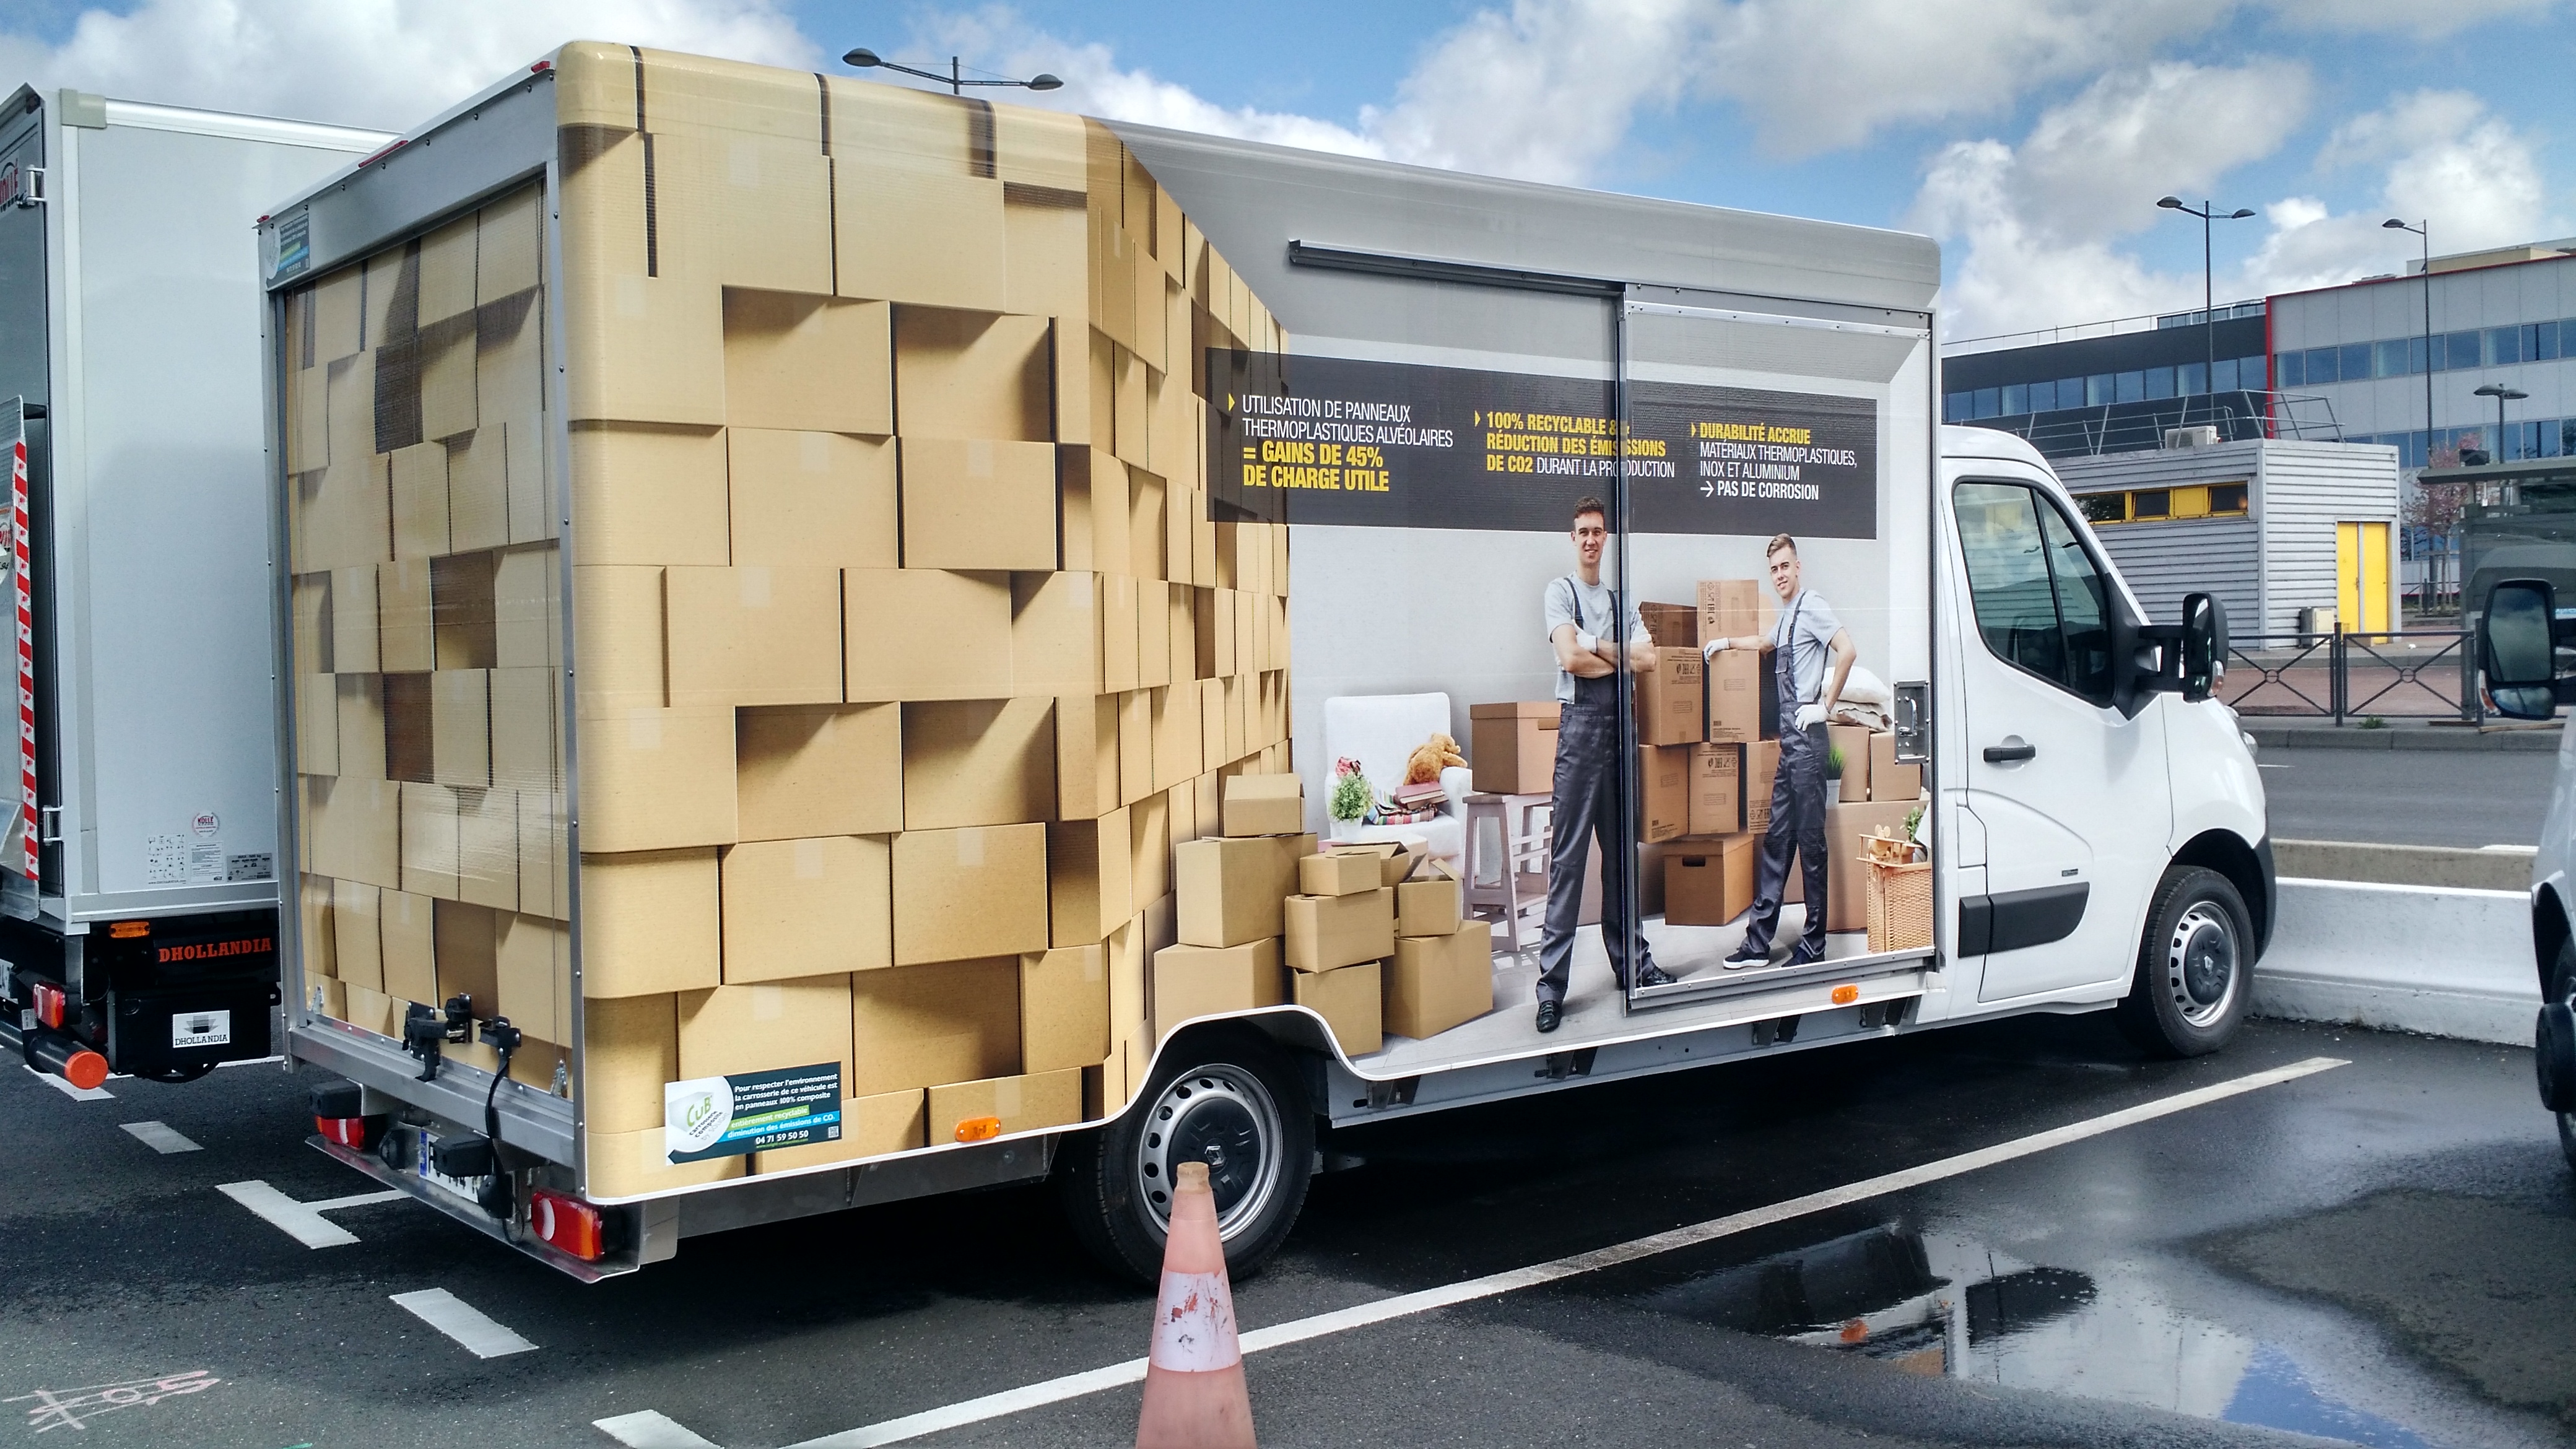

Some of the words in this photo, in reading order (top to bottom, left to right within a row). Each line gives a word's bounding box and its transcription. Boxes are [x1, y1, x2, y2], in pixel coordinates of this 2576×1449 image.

[1243, 394, 1320, 417] UTILISATION
[1325, 400, 1342, 419] DE
[1346, 401, 1411, 422] PANNEAUX
[1242, 418, 1373, 443] THERMOPLASTIQUES
[1376, 423, 1453, 447] ALVÉOLAIRES
[1487, 411, 1523, 430] 100%
[1528, 414, 1606, 435] RECYCLABLE
[1700, 422, 1765, 442] DURABILITÉ
[1767, 427, 1811, 445] ACCRUE
[1487, 429, 1558, 453] RÉDUCTION
[1562, 437, 1586, 455] DES
[1700, 439, 1757, 460] MATÉRIAUX
[1757, 445, 1857, 468] THERMOPLASTIQUES,
[1262, 440, 1315, 464] GAINS
[1320, 443, 1342, 466] DE
[1346, 445, 1383, 468] 45%
[1487, 454, 1504, 471] DE
[1507, 455, 1533, 473] CO2
[1537, 457, 1582, 475] DURANT
[1583, 459, 1597, 476] LA
[1243, 464, 1266, 486] DE
[1271, 466, 1340, 490] CHARGE
[1344, 469, 1389, 492] UTILE
[1700, 461, 1725, 477] INOX
[1728, 462, 1741, 477] ET
[1742, 463, 1799, 481] ALUMINIUM
[1717, 481, 1738, 497] PAS
[1741, 481, 1756, 497] DE
[1758, 482, 1819, 500] CORROSION
[159, 938, 272, 962] DHOLLANDIA
[175, 1034, 228, 1046] DHOLLANDIA
[742, 1090, 780, 1100] carrosserie
[799, 1084, 827, 1092] véhicule
[752, 1081, 784, 1090] respecter
[785, 1073, 838, 1086] l'environnement
[745, 1099, 778, 1110] panneaux
[796, 1092, 831, 1102] composite
[689, 1111, 718, 1136] carrosserie
[695, 1112, 723, 1138] composite
[727, 1127, 765, 1138] diminution
[779, 1119, 812, 1129] émissions
[731, 1114, 773, 1128] entièrement
[774, 1108, 807, 1119] recyclable
[755, 1136, 765, 1144] 04
[767, 1134, 775, 1143] 71
[777, 1133, 786, 1142] 59
[788, 1131, 798, 1140] 50
[799, 1129, 809, 1138] 50
